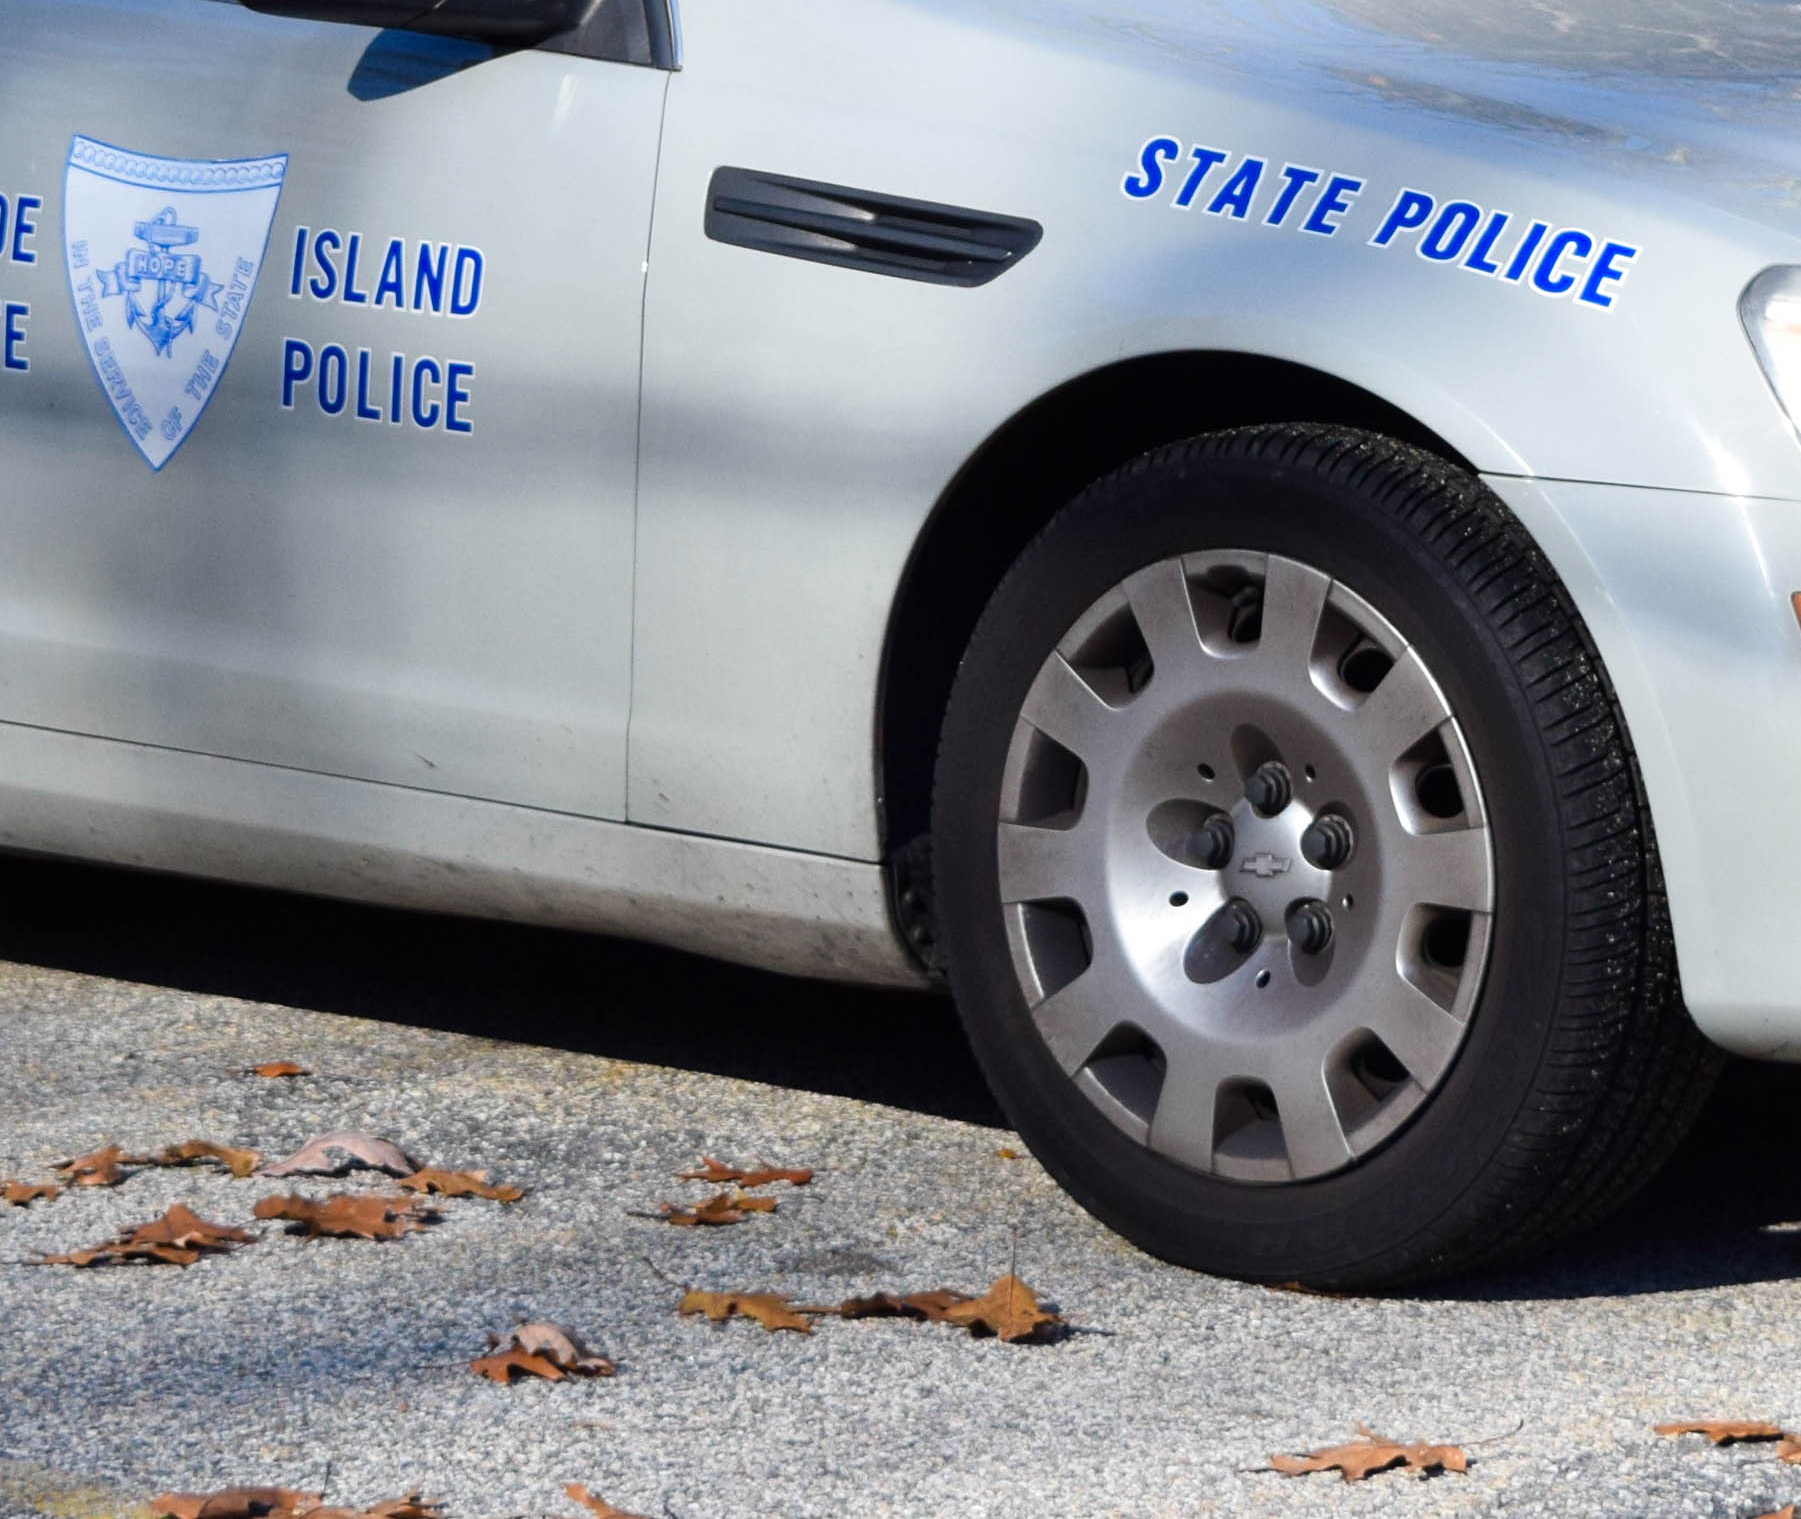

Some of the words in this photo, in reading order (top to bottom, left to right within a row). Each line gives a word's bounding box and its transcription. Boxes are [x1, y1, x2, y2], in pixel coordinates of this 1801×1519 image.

[136, 255, 186, 276] HOPE
[288, 225, 486, 319] ISLAND
[1123, 135, 1366, 237] STATE
[1368, 187, 1642, 312] POLICE
[94, 336, 152, 441] SERVICE
[160, 405, 183, 441] OF
[184, 349, 220, 401] THE
[215, 256, 255, 341] STATE
[281, 337, 476, 435] POLICE
